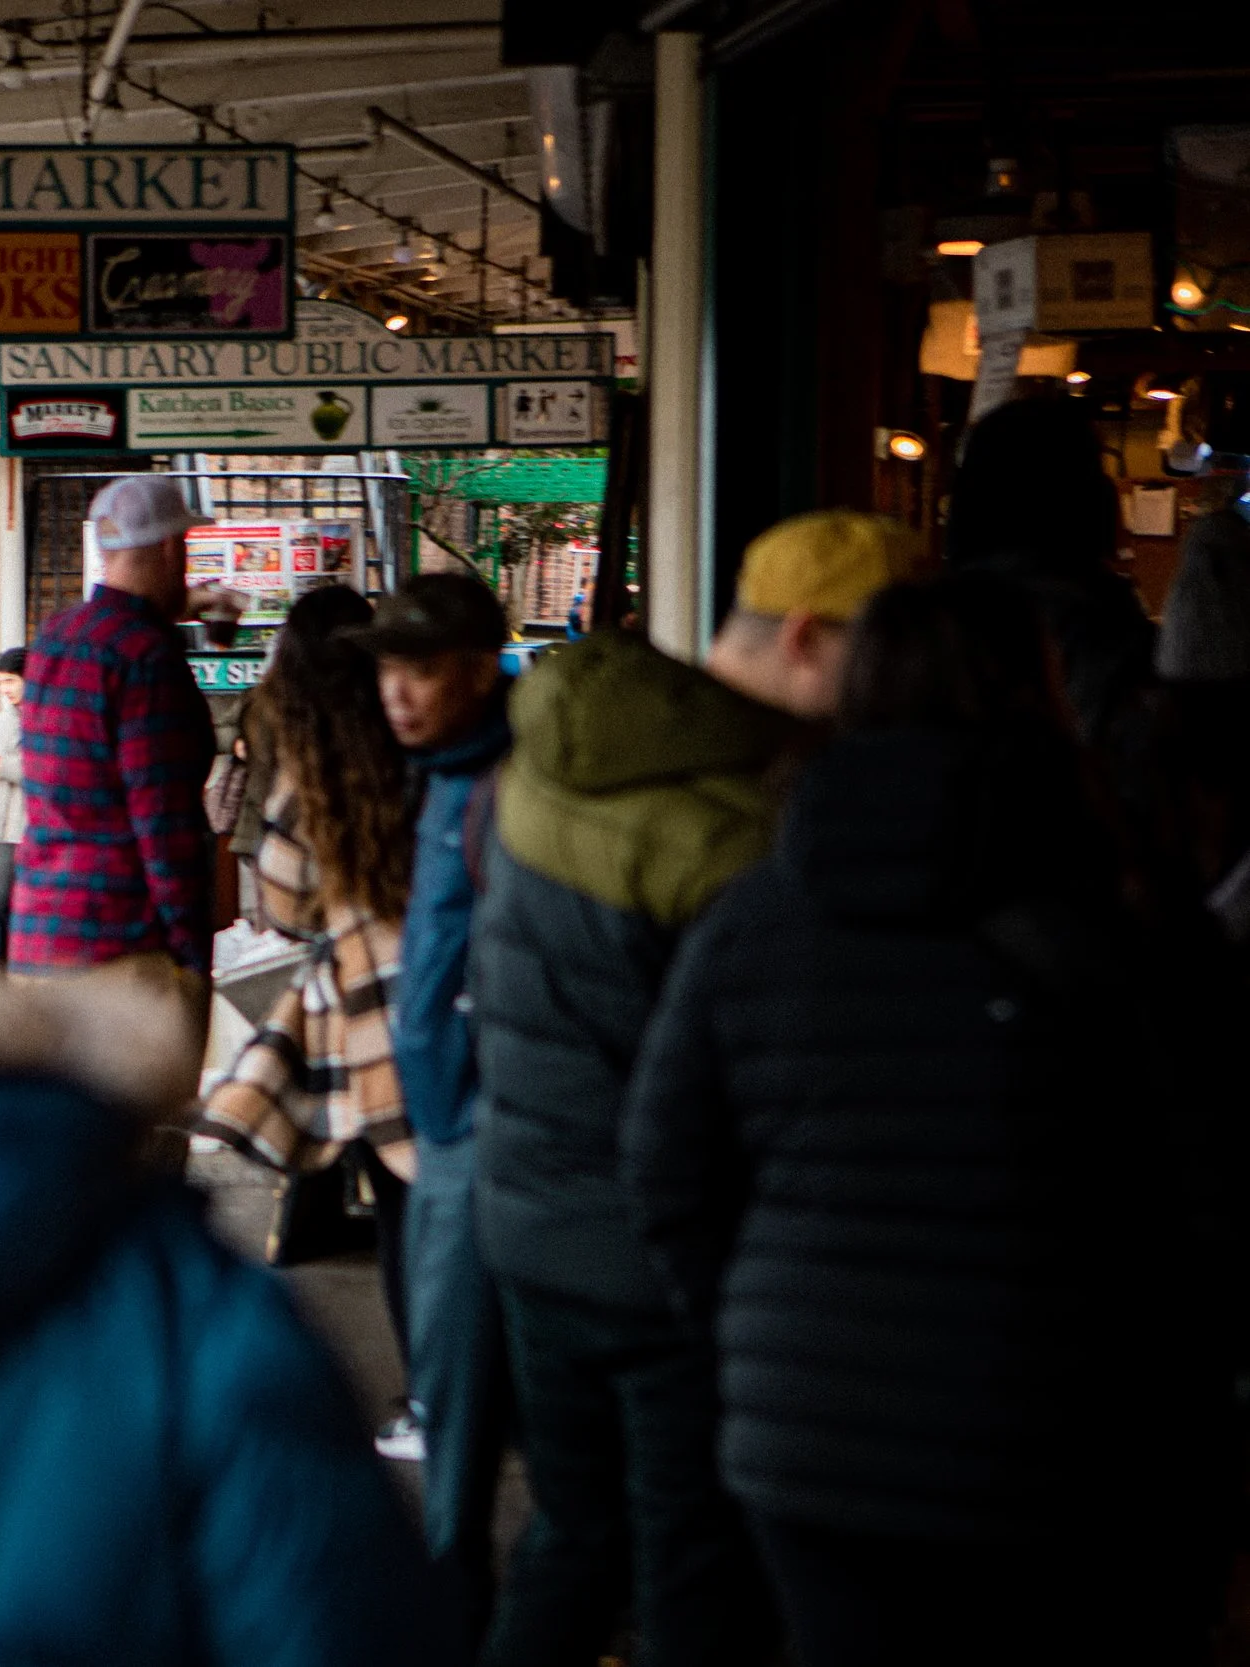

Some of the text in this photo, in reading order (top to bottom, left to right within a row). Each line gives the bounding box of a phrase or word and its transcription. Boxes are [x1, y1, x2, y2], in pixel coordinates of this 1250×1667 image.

[7, 337, 605, 380] SANITARY PUBLIC MARKET
[26, 403, 100, 423] MARKET
[138, 391, 295, 413] Kitchen Basics
